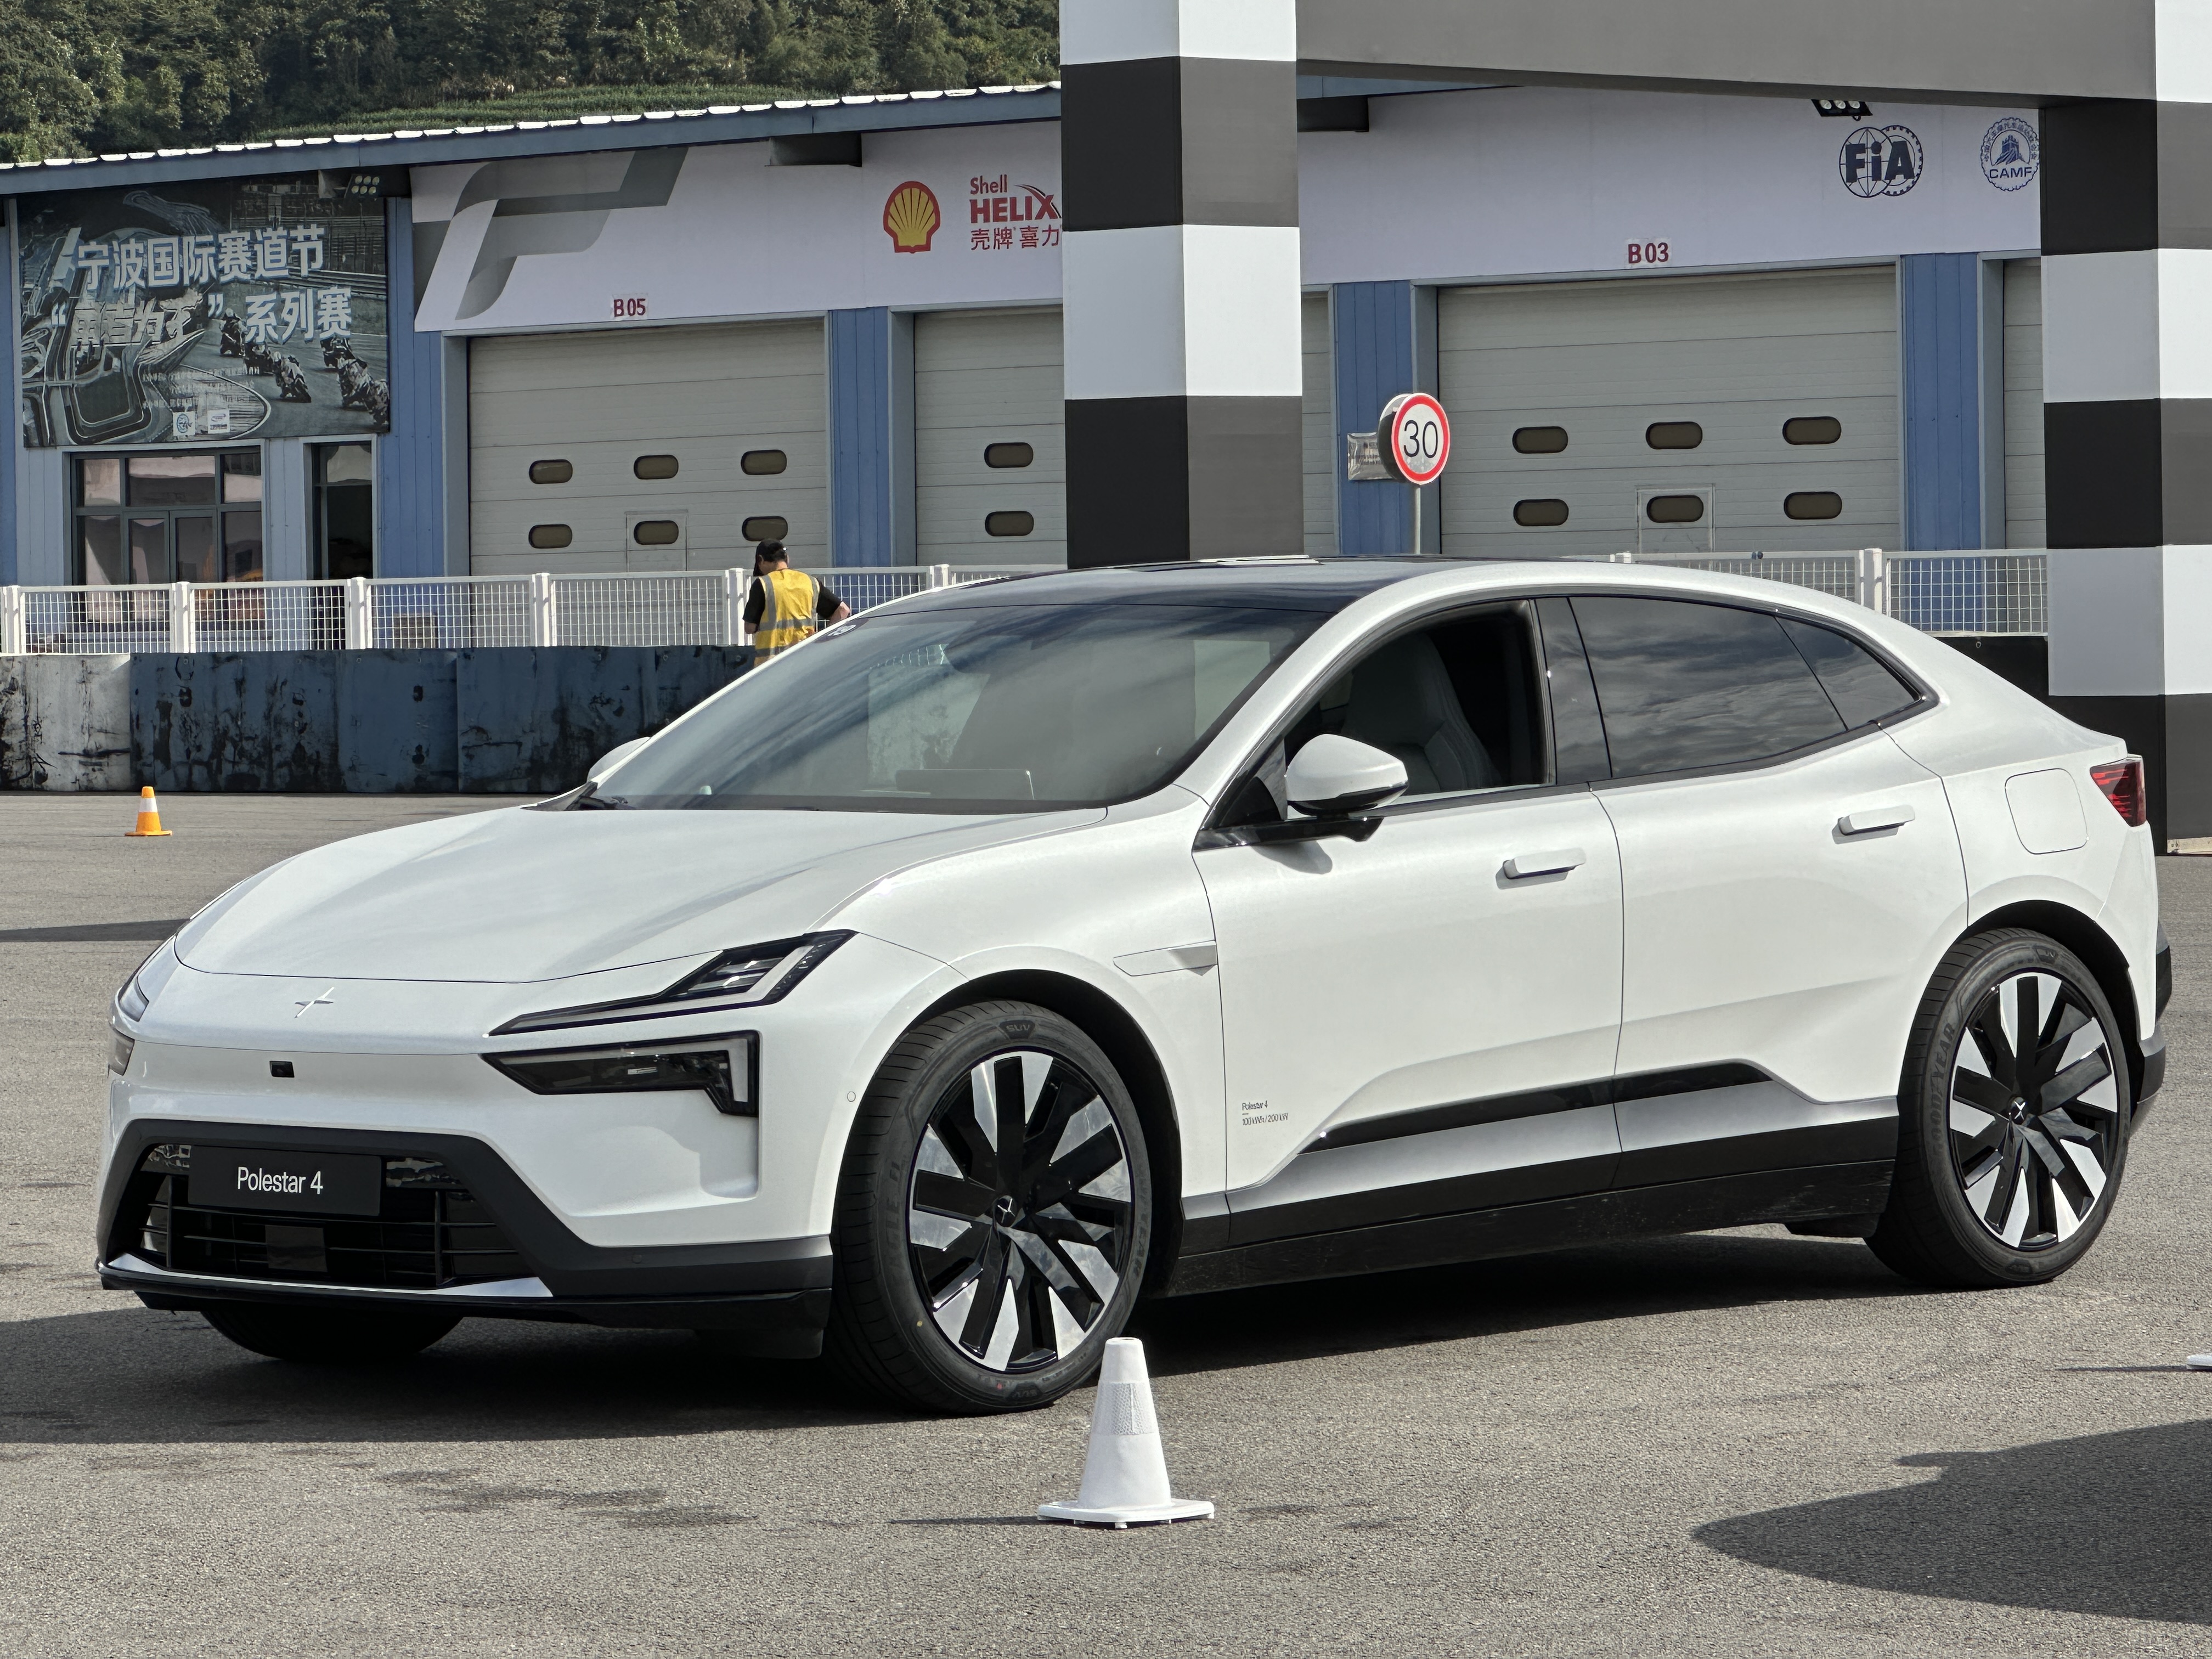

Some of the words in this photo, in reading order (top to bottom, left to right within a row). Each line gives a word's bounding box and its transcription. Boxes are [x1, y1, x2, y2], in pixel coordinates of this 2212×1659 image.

[970, 174, 1007, 195] Shell
[1989, 167, 2032, 178] CAMF
[969, 194, 1060, 223] HELIX
[77, 224, 325, 290] 宁波国际赛道节
[1628, 242, 1669, 263] B03
[614, 298, 646, 317] B05
[1403, 420, 1438, 459] 30
[238, 1166, 306, 1193] Polestar
[310, 1171, 323, 1194] 4
